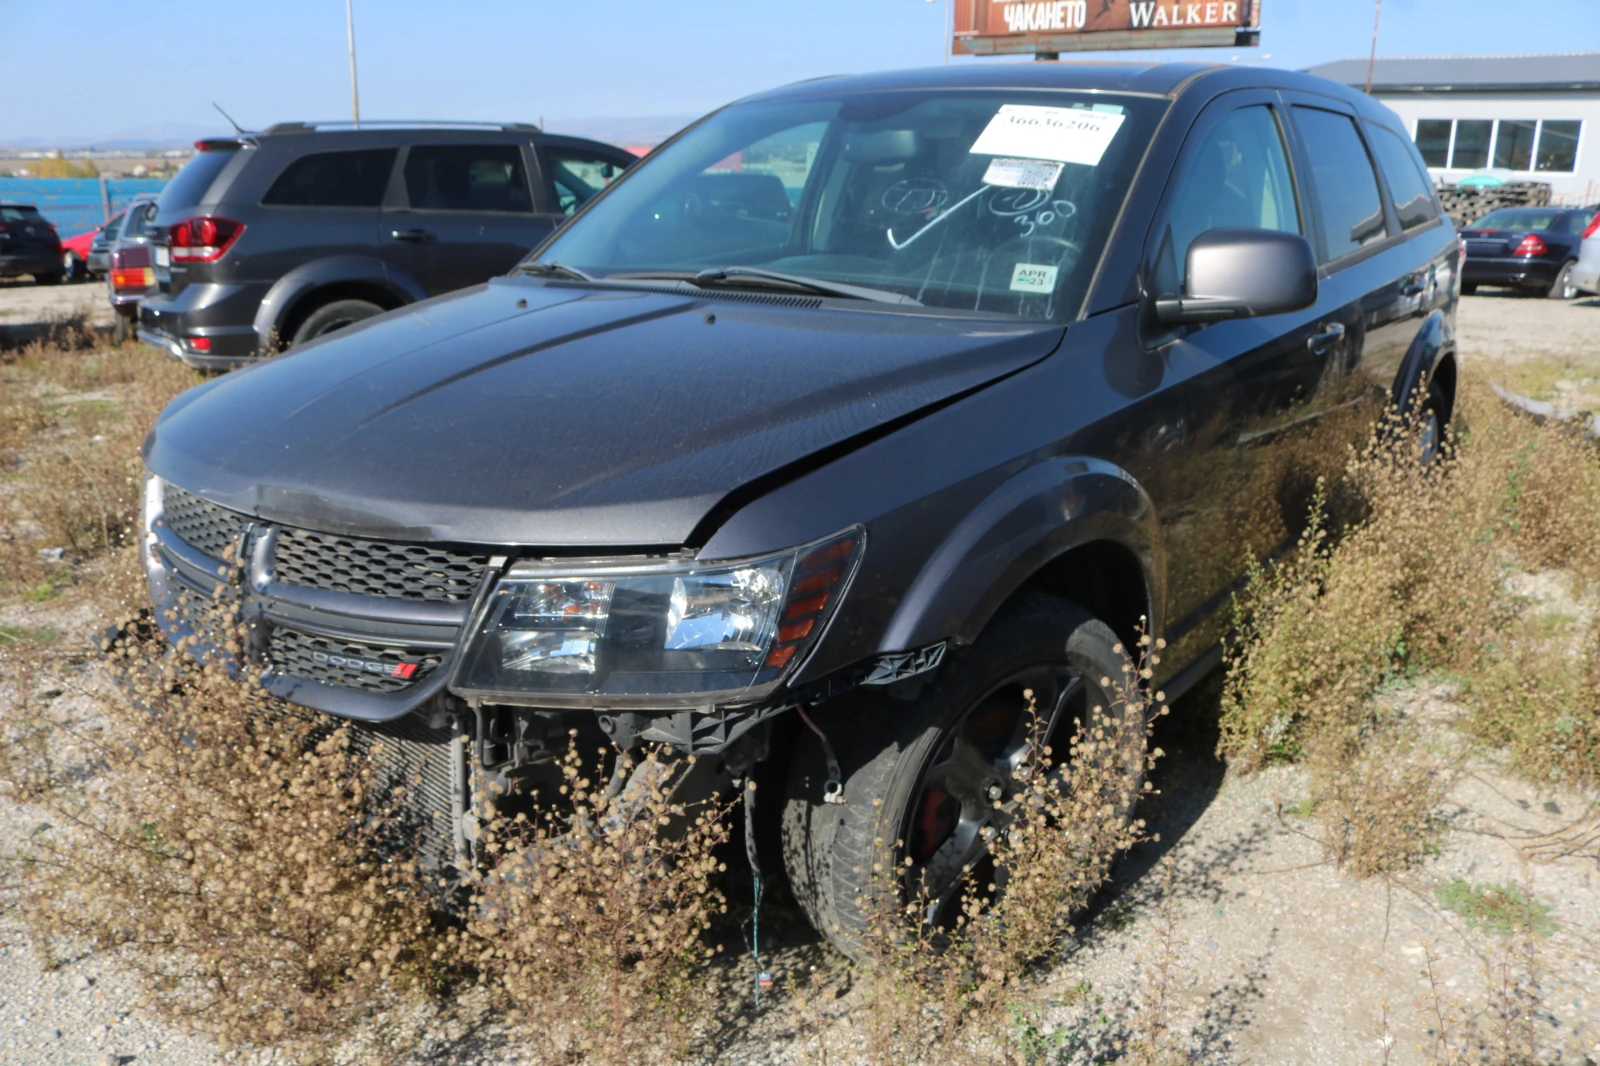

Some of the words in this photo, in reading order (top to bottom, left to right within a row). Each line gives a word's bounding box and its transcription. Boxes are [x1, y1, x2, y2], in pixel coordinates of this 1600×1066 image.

[1004, 0, 1087, 32] ЧАКАНЕТО
[1129, 1, 1238, 28] WALKER
[1018, 268, 1047, 278] APR
[312, 650, 402, 676] DODGE
